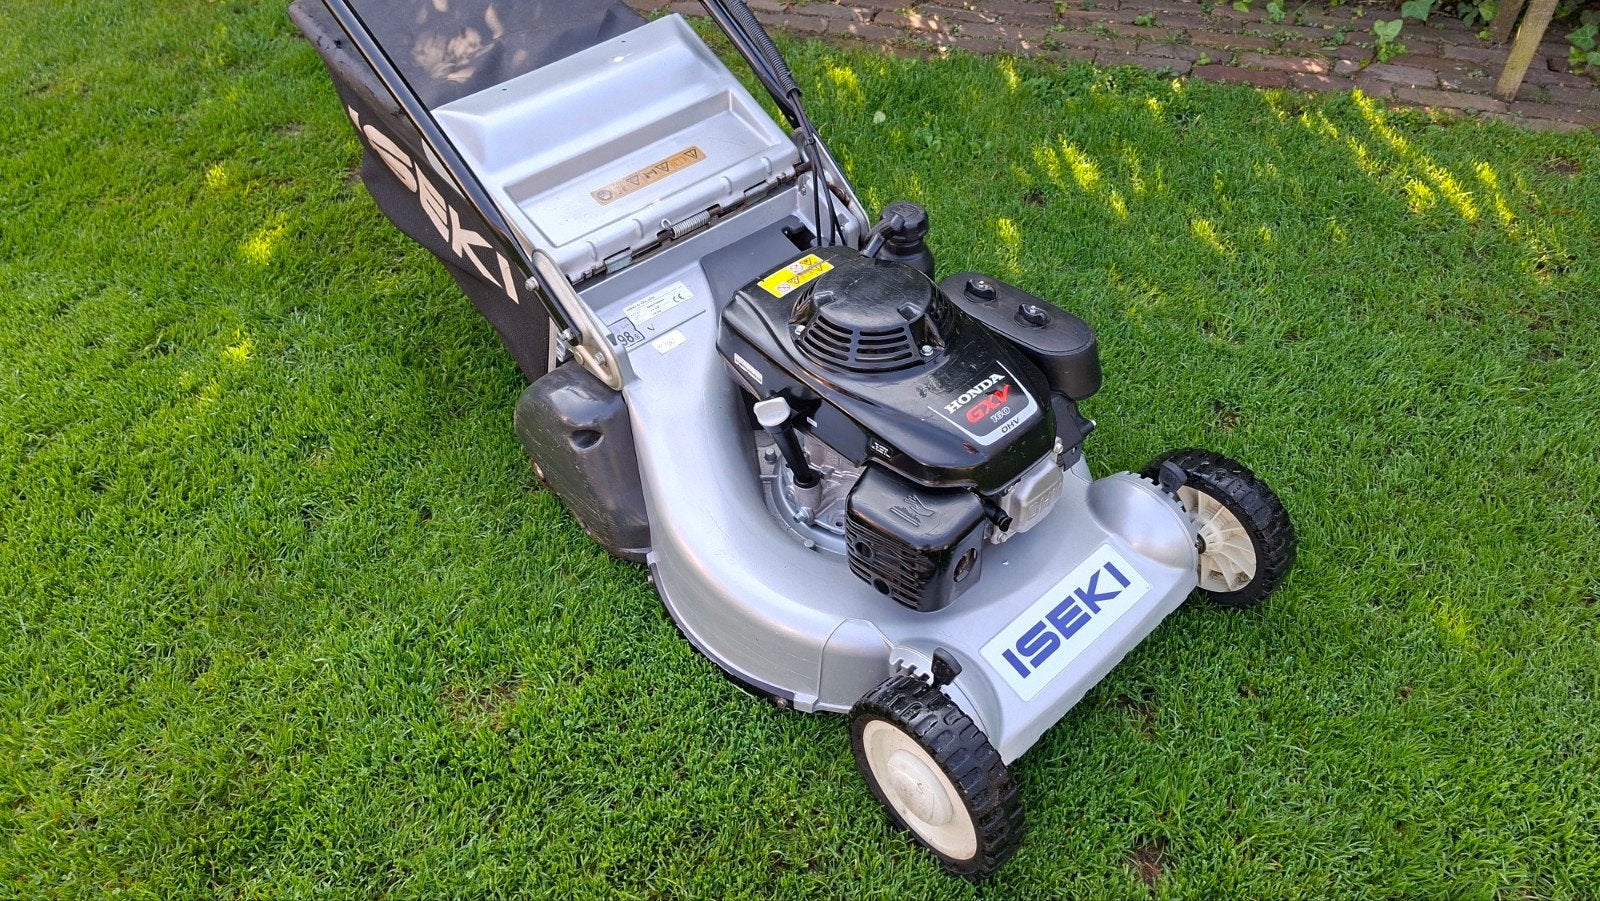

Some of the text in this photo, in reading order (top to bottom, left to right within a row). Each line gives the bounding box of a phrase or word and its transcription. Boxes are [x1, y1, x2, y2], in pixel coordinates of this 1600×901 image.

[617, 331, 635, 346] 98
[944, 373, 1006, 414] HONDA
[966, 384, 1011, 423] GXV
[990, 406, 1011, 423] 160
[1001, 417, 1020, 434] OHV
[1002, 561, 1131, 679] ISEKI
